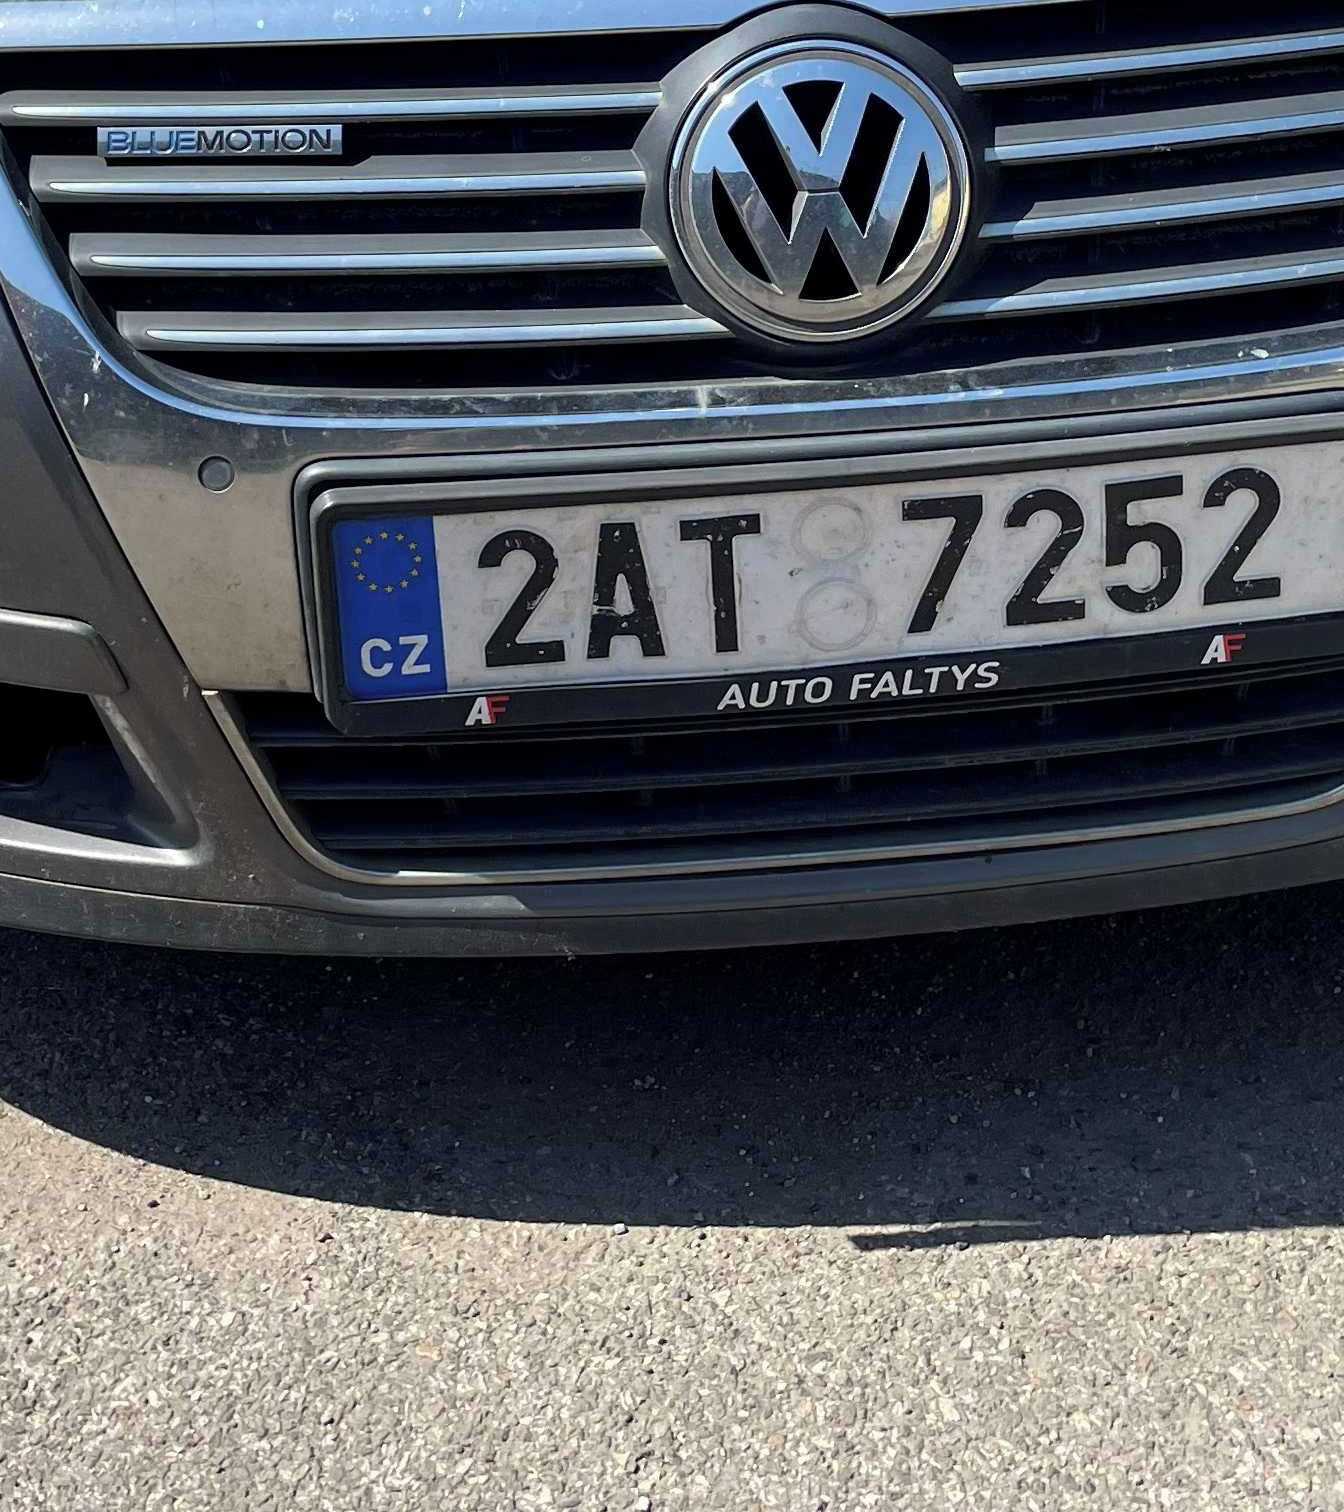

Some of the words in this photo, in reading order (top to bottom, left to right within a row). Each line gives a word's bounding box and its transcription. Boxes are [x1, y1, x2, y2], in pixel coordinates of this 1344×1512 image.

[106, 128, 332, 155] BLUEMOTION
[708, 72, 940, 304] VW
[477, 513, 761, 668] 2AT
[902, 467, 1282, 634] 7252
[360, 634, 431, 677] CZ
[716, 676, 833, 711] AUTO
[848, 661, 1000, 701] FALTYS
